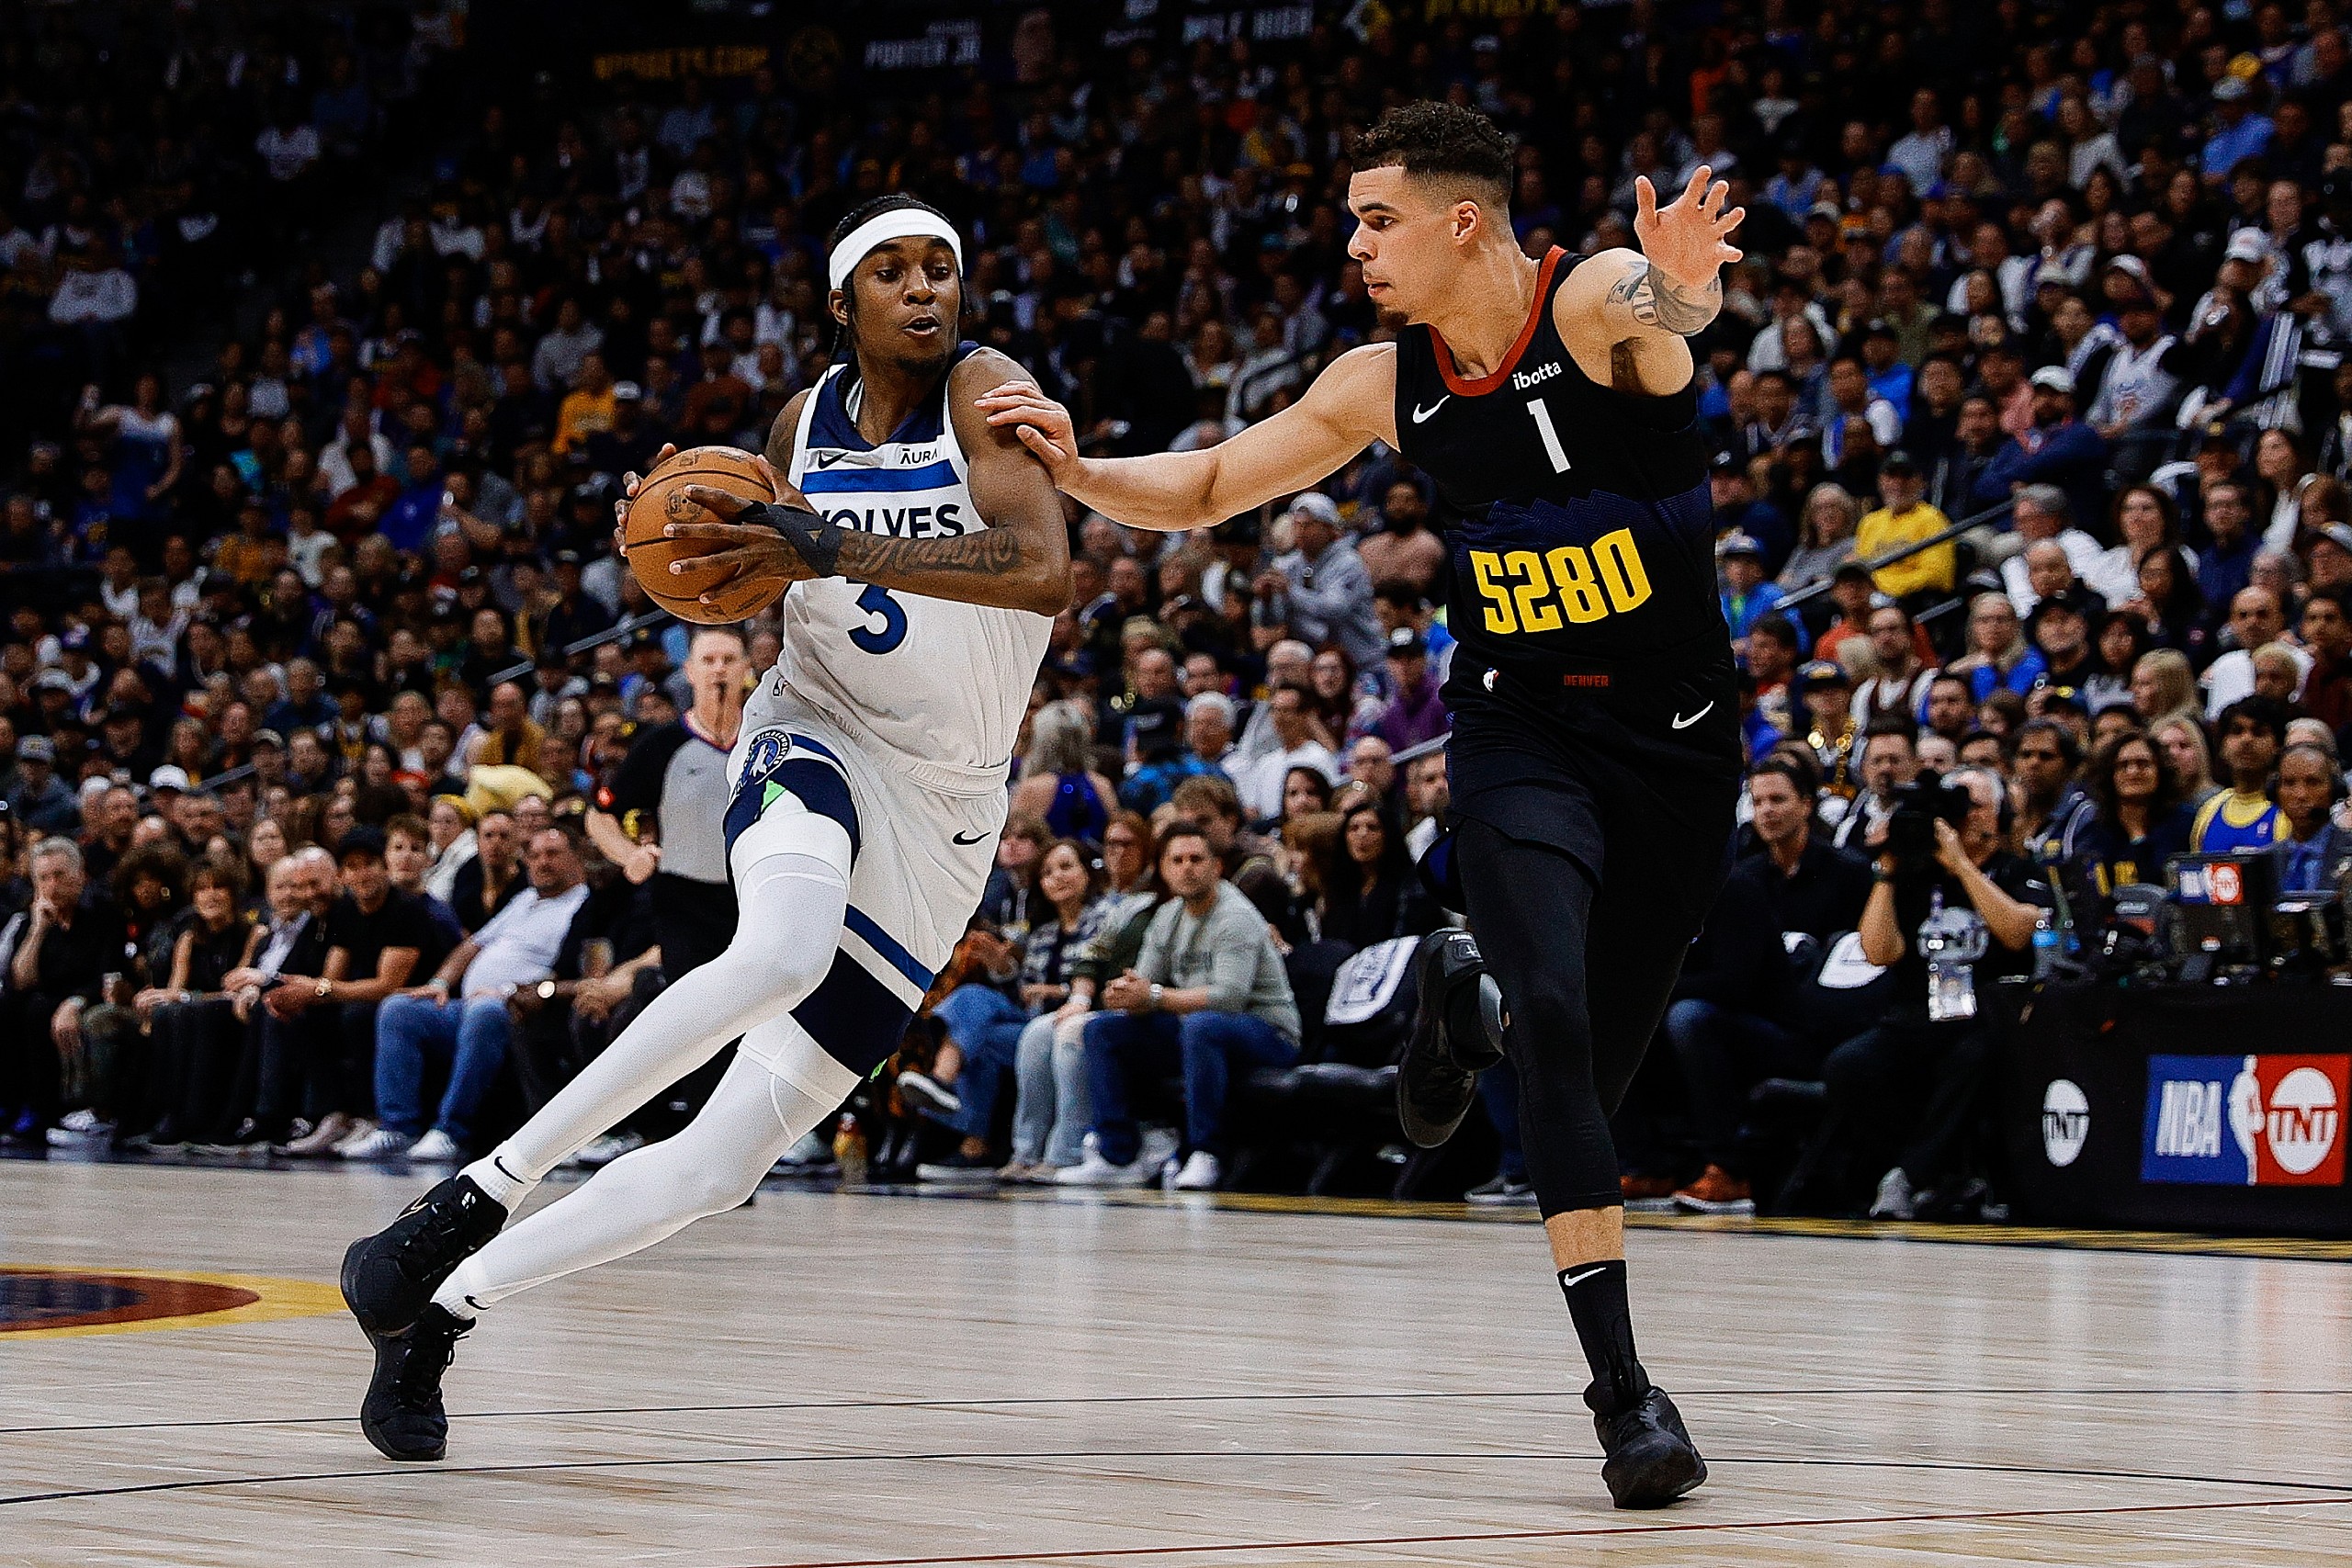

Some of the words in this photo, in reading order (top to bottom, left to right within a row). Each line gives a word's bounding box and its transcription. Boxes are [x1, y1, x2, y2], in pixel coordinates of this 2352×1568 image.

[1513, 361, 1562, 390] ibotta
[1527, 398, 1571, 473] 1
[822, 503, 965, 540] OLVES
[846, 576, 909, 655] 3
[1469, 526, 1653, 634] 5280
[1564, 675, 1609, 686] DENVER
[2156, 1080, 2222, 1157] NBA
